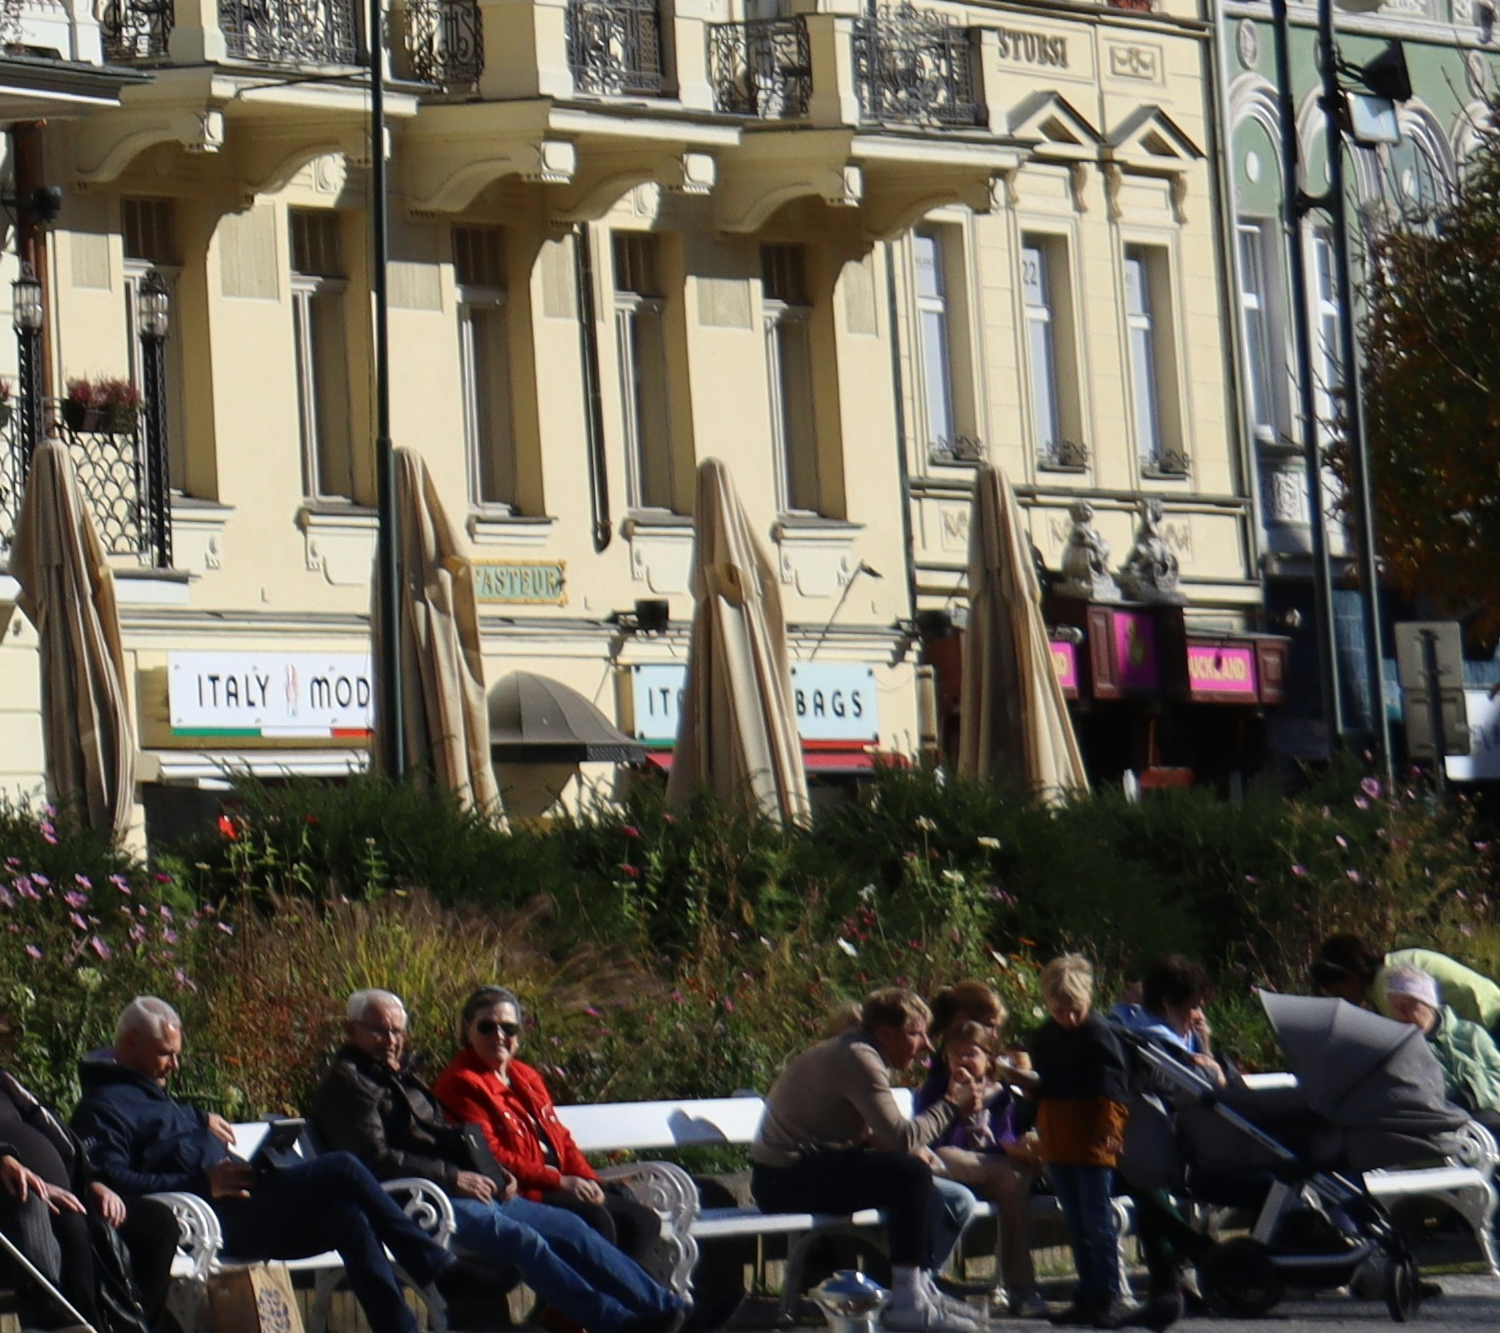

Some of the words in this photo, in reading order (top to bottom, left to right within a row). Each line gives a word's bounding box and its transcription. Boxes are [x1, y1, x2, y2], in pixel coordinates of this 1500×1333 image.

[1022, 260, 1038, 287] 22
[197, 674, 270, 709] ITALY
[796, 688, 864, 718] BAGS
